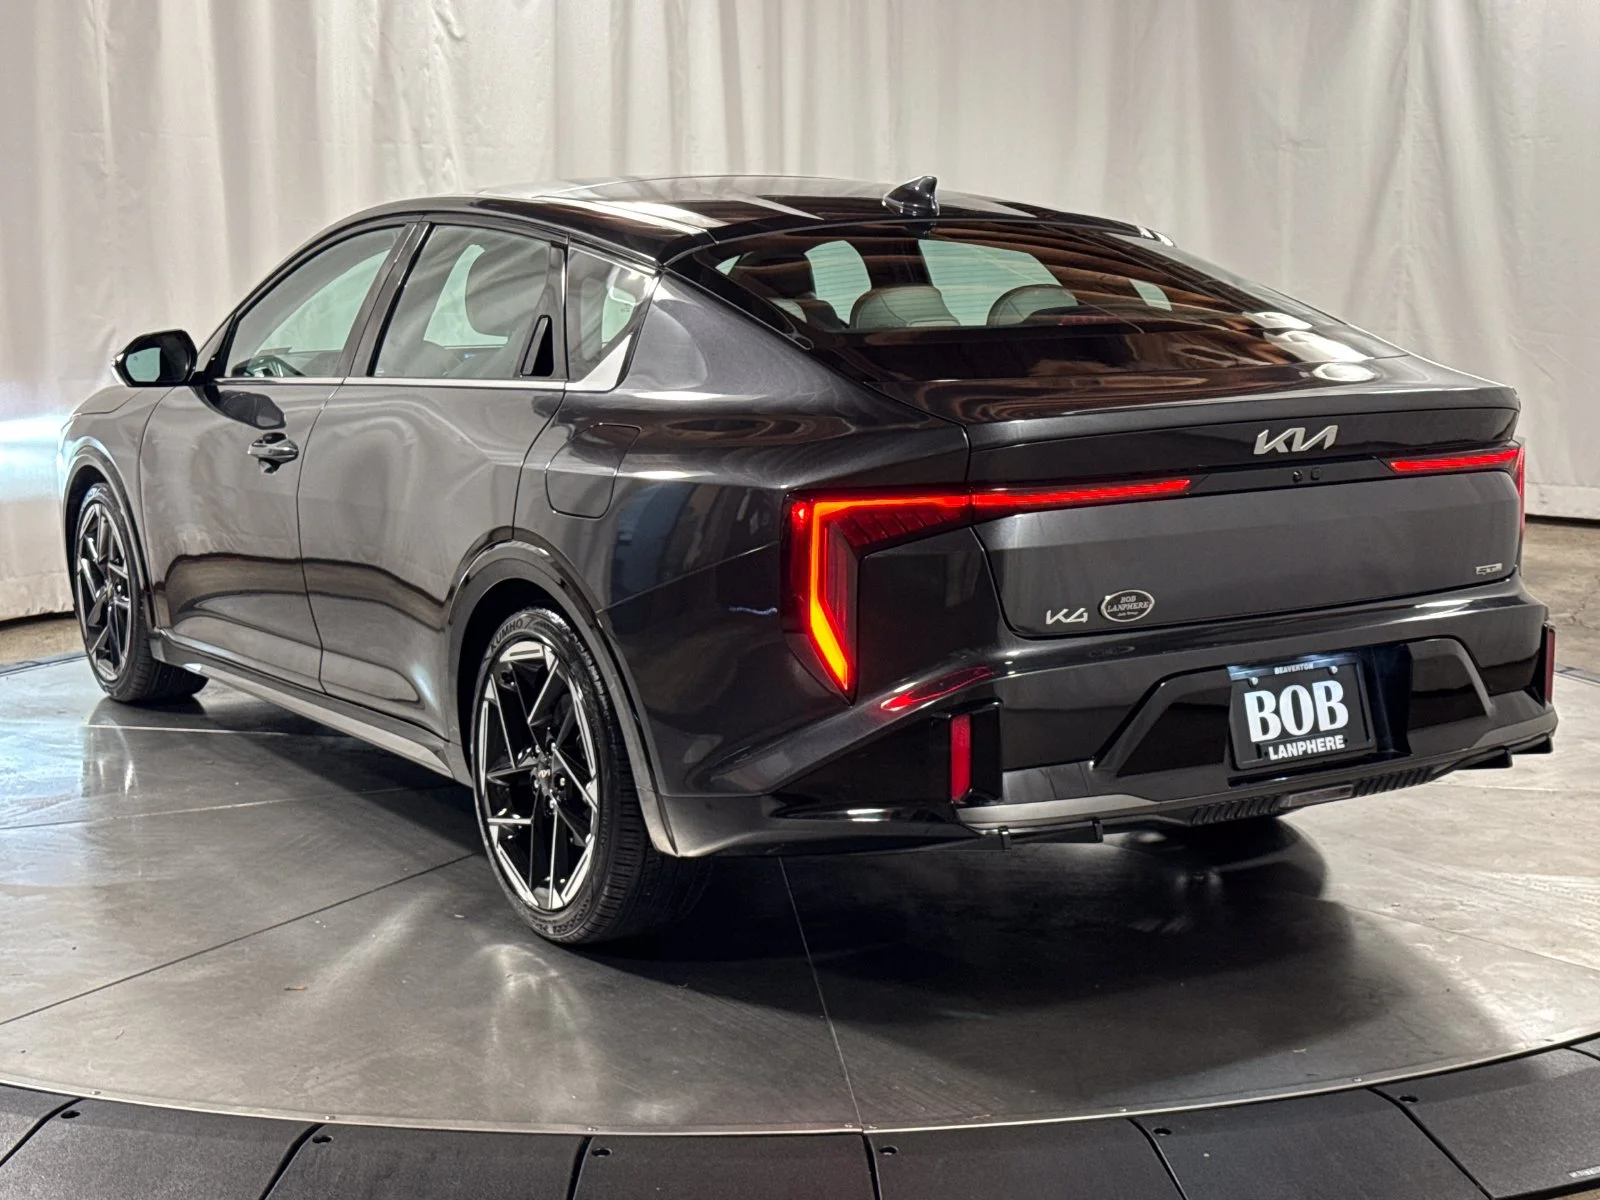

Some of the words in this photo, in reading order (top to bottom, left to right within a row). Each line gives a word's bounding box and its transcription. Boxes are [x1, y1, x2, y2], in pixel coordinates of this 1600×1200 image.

[1253, 425, 1338, 454] KIA
[1107, 601, 1149, 612] LANPHERE
[1120, 595, 1137, 604] BOB
[1045, 607, 1088, 625] K4
[490, 618, 523, 653] KUMHO
[1274, 662, 1314, 675] BEAVERTON
[1244, 680, 1349, 743] BOB
[1268, 735, 1345, 760] LANPHERE
